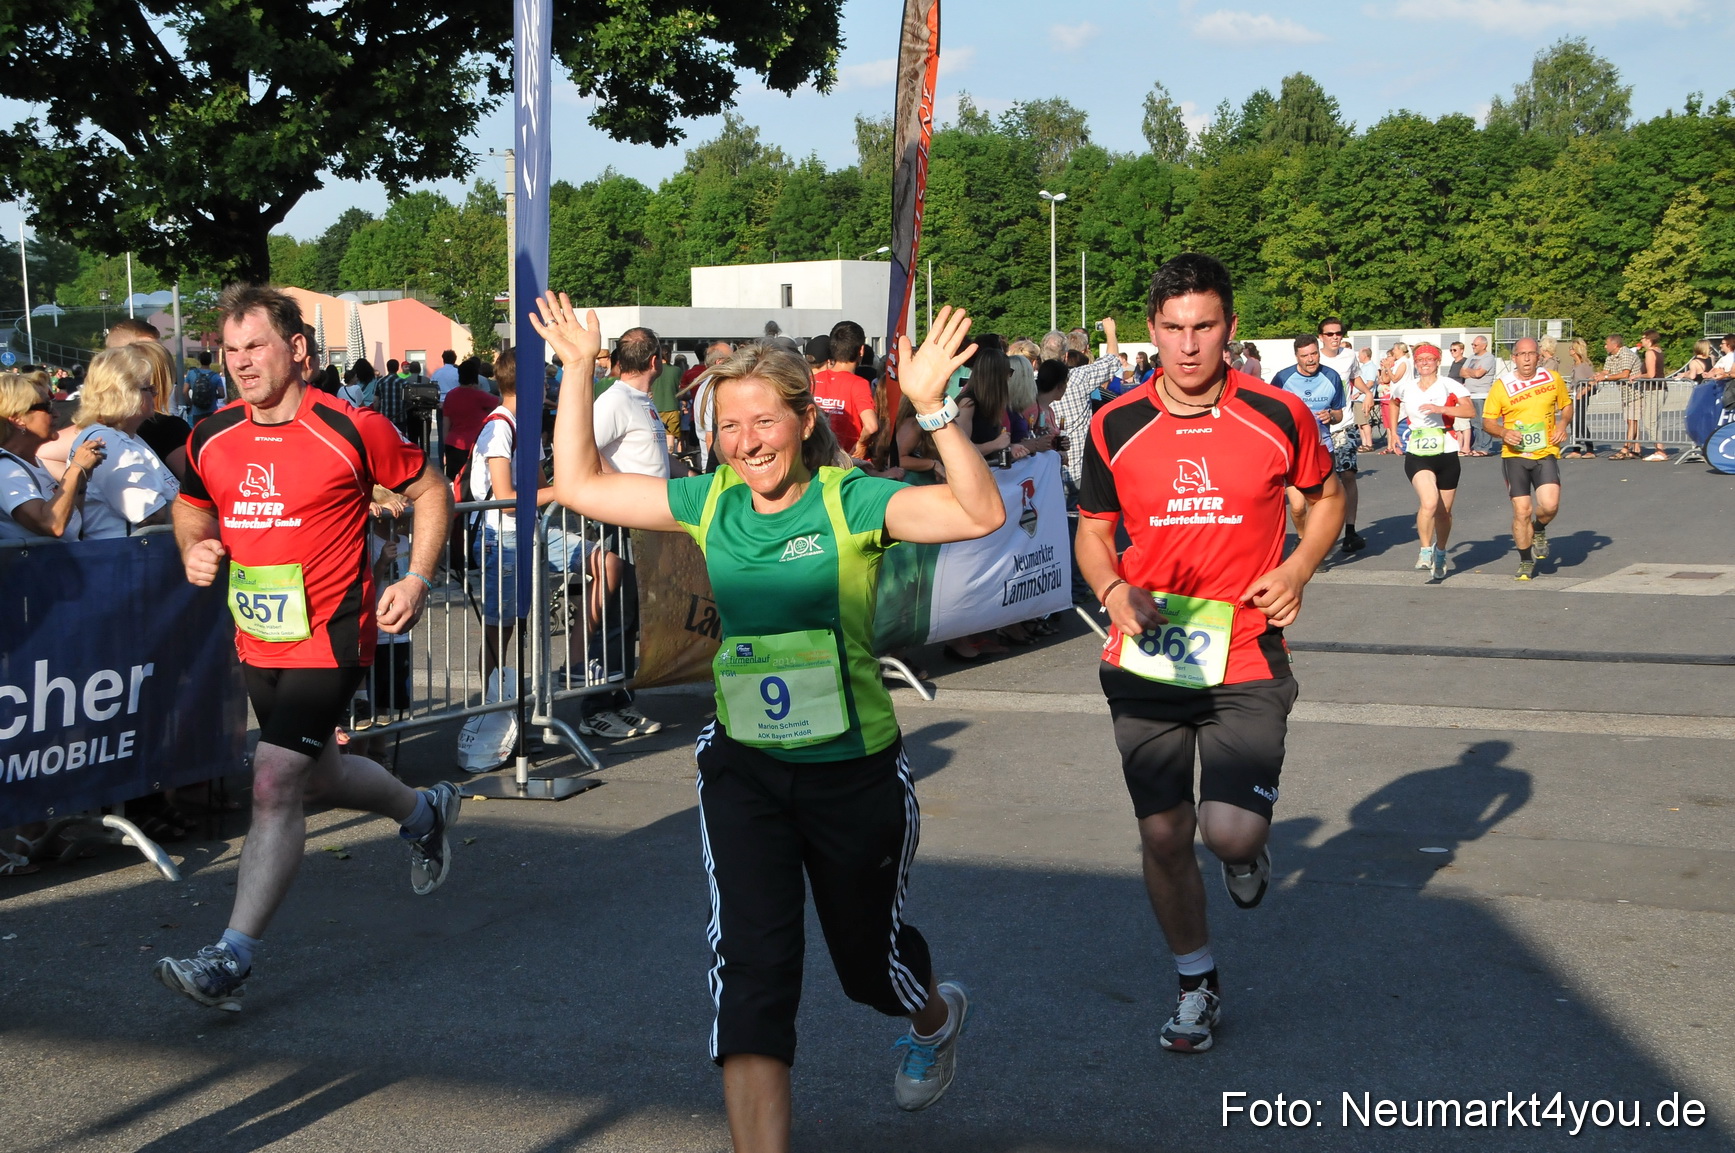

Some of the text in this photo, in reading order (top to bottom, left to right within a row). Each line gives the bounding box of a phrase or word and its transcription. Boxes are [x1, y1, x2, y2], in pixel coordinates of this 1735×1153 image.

[1510, 384, 1557, 406] MAX BÖGL
[1414, 437, 1438, 449] 123
[1522, 433, 1541, 445] 98
[233, 501, 284, 516] MEYER
[1167, 497, 1224, 512] MEYER
[275, 517, 302, 527] GmbH
[1149, 512, 1244, 527] Fördertechnik GmbH
[781, 533, 822, 559] AOK
[1013, 544, 1054, 573] Neumarkter
[1002, 564, 1062, 607] Lammsbräu
[236, 592, 289, 623] 857
[1138, 624, 1211, 666] 862
[730, 654, 770, 664] firmenlauf
[0, 659, 154, 740] cher
[760, 676, 791, 721] 9
[758, 719, 809, 730] Marion Schmidt
[771, 732, 792, 740] Bayern
